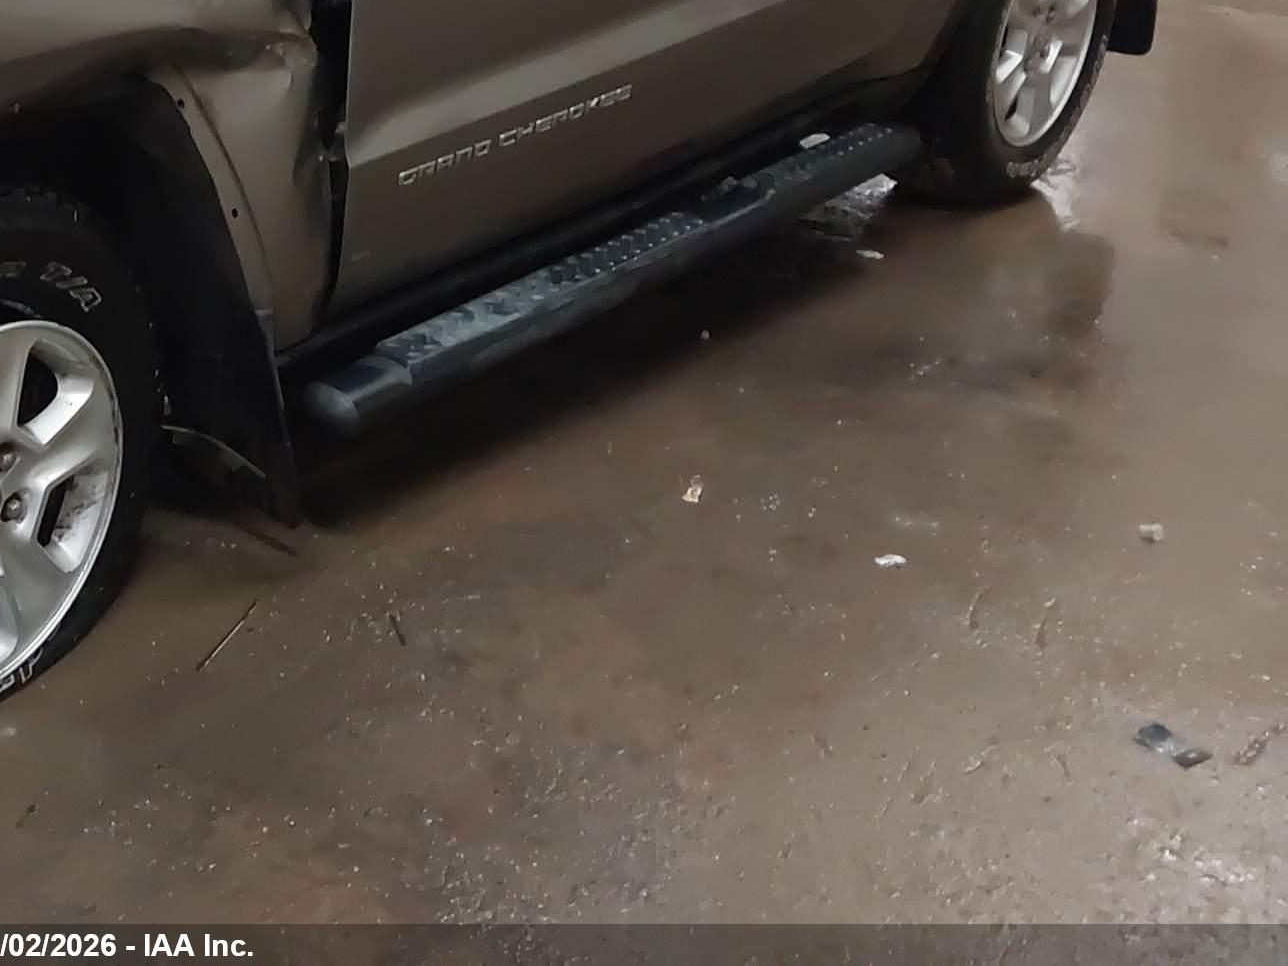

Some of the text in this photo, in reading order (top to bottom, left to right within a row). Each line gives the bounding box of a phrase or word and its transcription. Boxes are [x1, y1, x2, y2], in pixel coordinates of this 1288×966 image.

[398, 83, 633, 186] GRAND CHEROKEE
[40, 261, 104, 314] T/A
